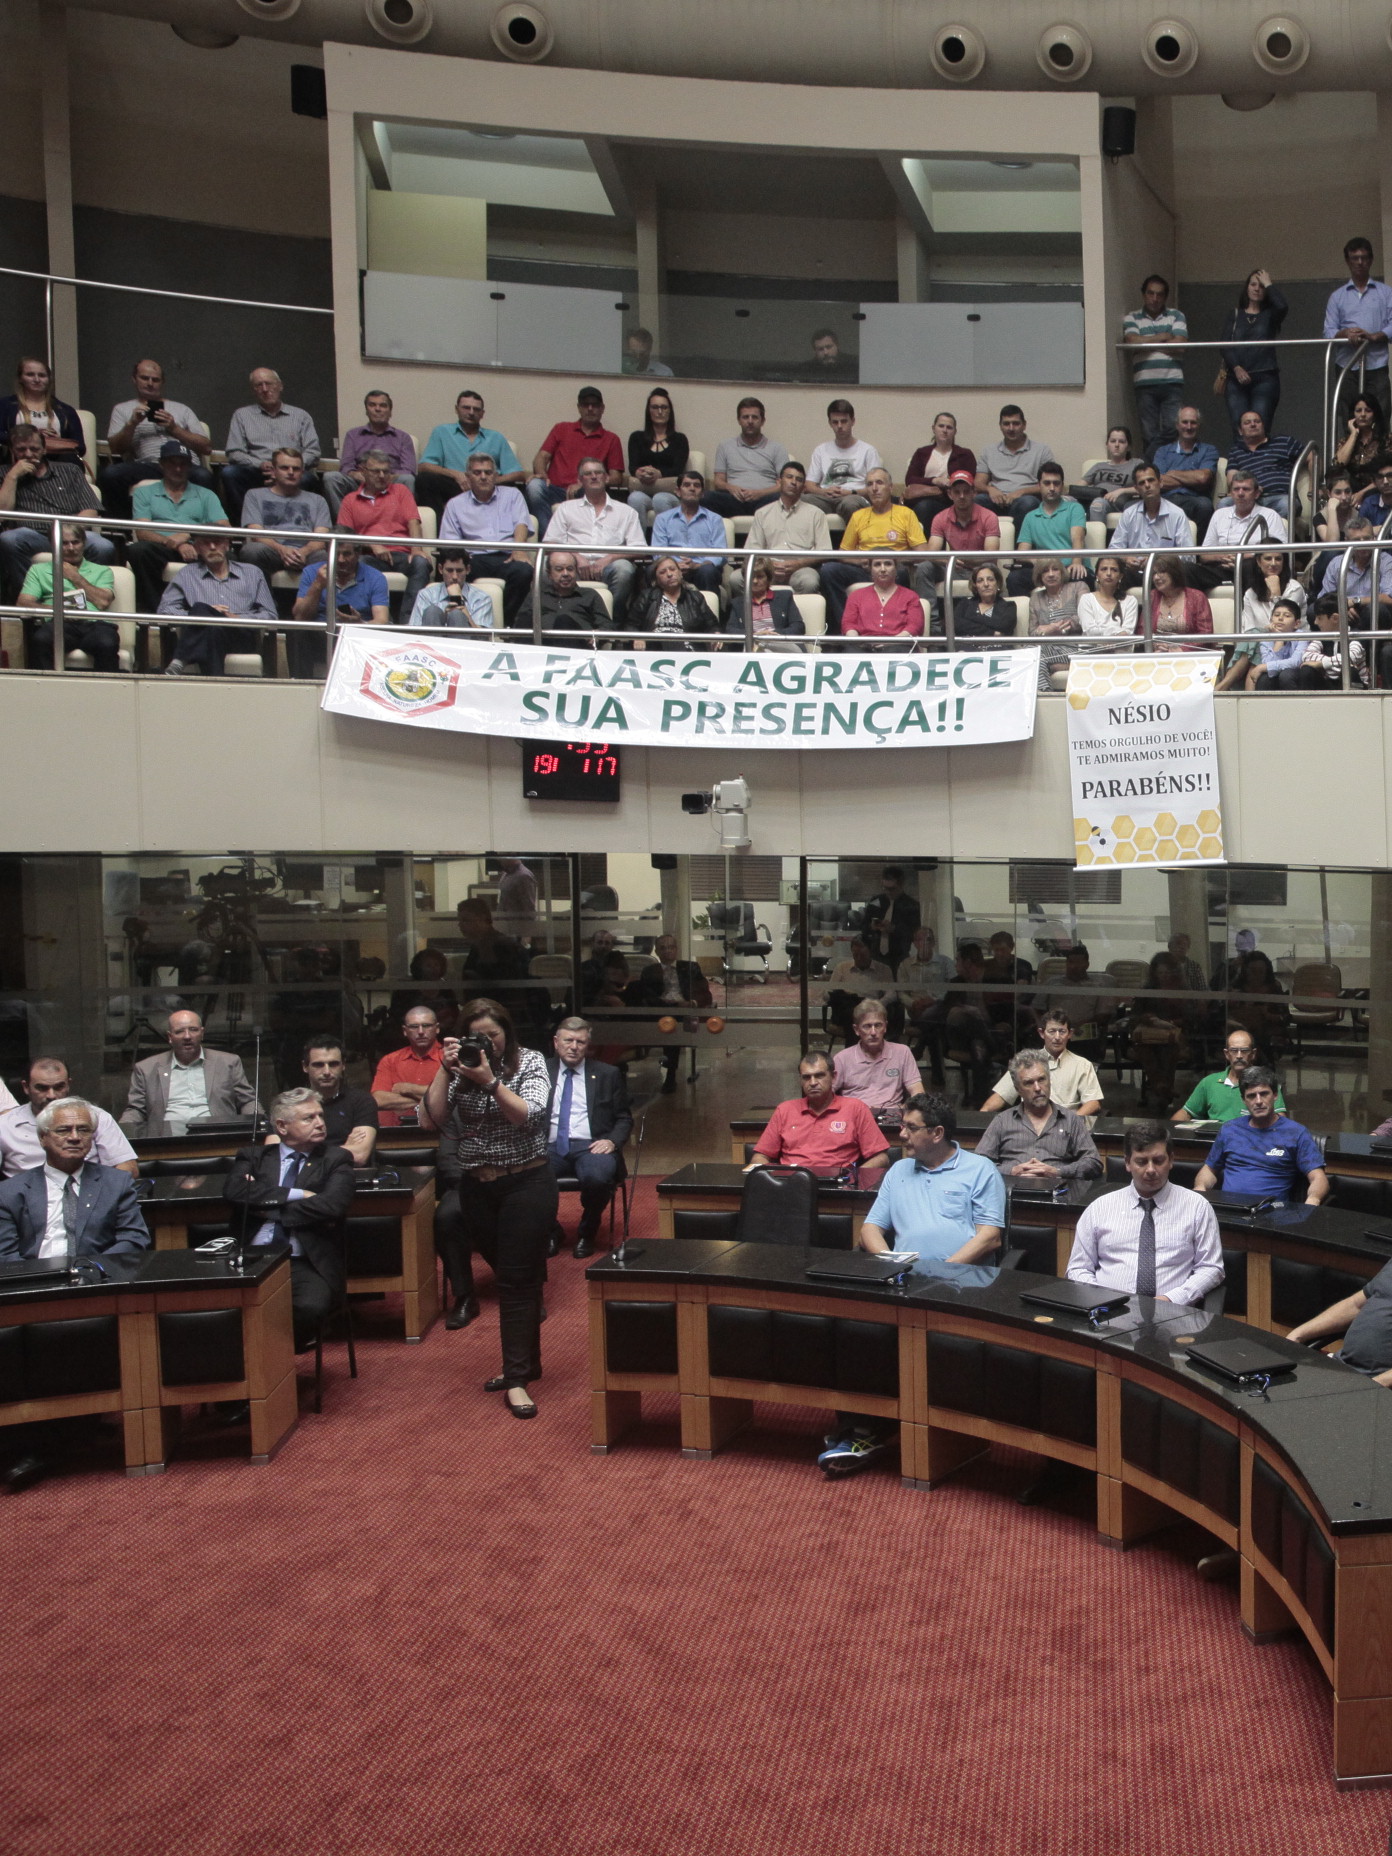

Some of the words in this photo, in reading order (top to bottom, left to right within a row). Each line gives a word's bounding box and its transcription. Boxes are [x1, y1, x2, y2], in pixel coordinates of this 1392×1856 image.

[395, 654, 437, 667] FAASC
[481, 650, 521, 682] A
[542, 653, 712, 693] FAASC
[733, 655, 1012, 695] AGRADECE
[519, 690, 630, 731] SUA
[660, 697, 966, 744] PRESENÇA!!
[1108, 701, 1171, 726] NÉSIO
[1072, 739, 1107, 750] TEMOS
[1109, 734, 1161, 748] ORGULHO
[1164, 733, 1179, 743] DE
[1181, 729, 1214, 742] VOCÊ!
[1077, 755, 1091, 766] TE
[1094, 749, 1165, 765] ADMIRAMOS
[1168, 746, 1210, 759] MUITO!
[1081, 770, 1212, 800] PARABÉNS!!
